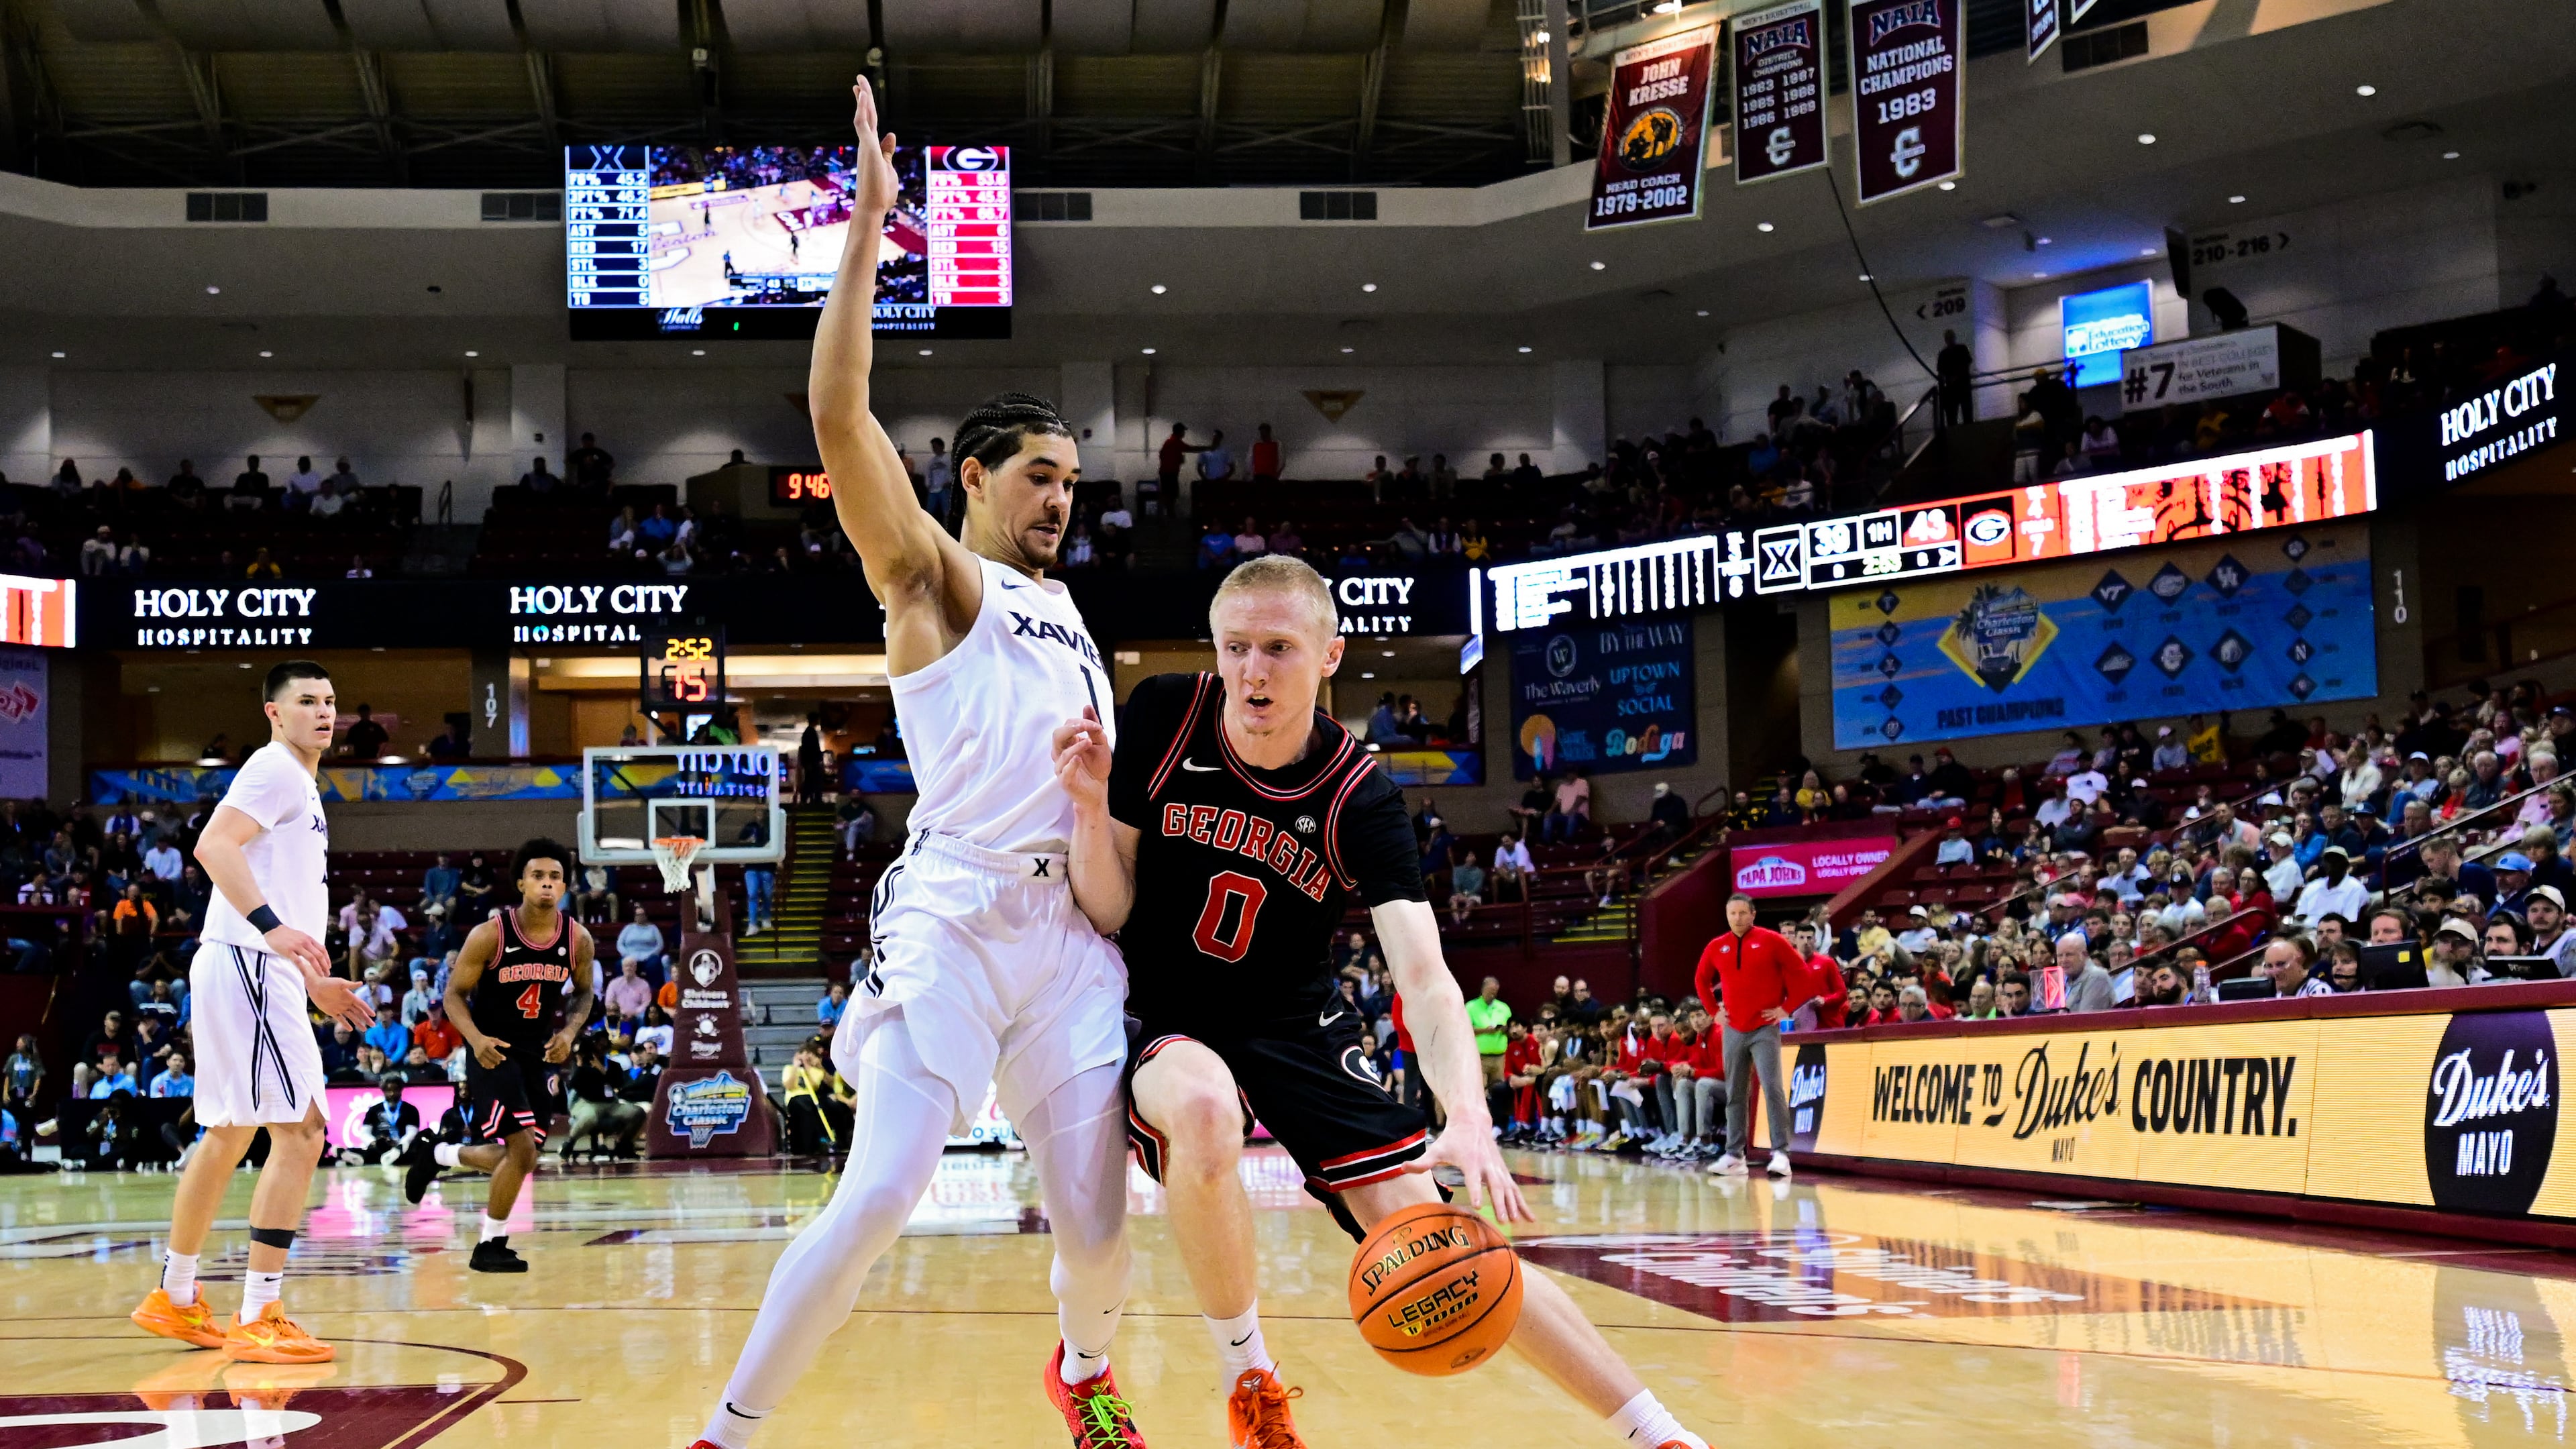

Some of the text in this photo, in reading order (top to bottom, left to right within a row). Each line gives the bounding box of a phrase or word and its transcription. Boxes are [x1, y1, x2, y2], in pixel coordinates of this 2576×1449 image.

[1869, 0, 1941, 47] NAIA
[1744, 18, 1811, 65] NAIA
[1866, 35, 1945, 74] NATIONAL
[1641, 57, 1682, 84] JOHN
[1752, 58, 1804, 78] CHAMPIONS
[1860, 54, 1953, 96] CHAMPIONS
[1628, 76, 1688, 107] KRESSE
[1742, 78, 1774, 97] 1983
[1878, 87, 1936, 125] 1983
[1743, 111, 1775, 129] 1986
[616, 173, 647, 185] 45.2
[1606, 173, 1681, 193] HEAD COACH
[616, 191, 647, 203] 46.2
[977, 191, 1006, 203] 45.5
[1596, 184, 1687, 217] 1979-2002
[570, 207, 647, 219] FT% 71.4
[570, 224, 647, 237] AST 5
[932, 224, 957, 237] AST
[631, 241, 647, 254] 17
[991, 241, 1008, 254] 15
[571, 258, 648, 271] STL 3
[932, 258, 1008, 271] STL 3
[998, 275, 1008, 287] 3
[639, 292, 649, 305] 5
[998, 292, 1008, 305] 3
[1933, 297, 1966, 317] 209
[905, 307, 936, 319] CITY
[2088, 320, 2149, 340] Education
[2089, 333, 2144, 352] Lottery
[2196, 364, 2246, 378] Veterans
[2249, 360, 2260, 370] in
[2125, 362, 2176, 404] #7
[2179, 377, 2233, 394] the South
[2440, 362, 2557, 446] HOLY CITY
[2445, 416, 2558, 482] HOSPITALITY
[1867, 520, 1892, 543] 1H
[1909, 508, 1947, 541] 43
[2029, 533, 2044, 556] 7
[510, 584, 688, 615] HOLY CITY
[1339, 577, 1415, 606] CITY
[134, 588, 316, 618] HOLY CITY
[138, 628, 312, 645] HOSPITALITY
[513, 625, 641, 642] HOSPITAL
[1007, 610, 1108, 677] XAVIE
[1648, 623, 1686, 647] WAY
[666, 638, 712, 661] 2:52
[1610, 661, 1680, 684] UPTOWN
[1080, 663, 1104, 730] 1
[1525, 683, 1548, 700] The
[484, 682, 498, 729] 107
[1617, 695, 1674, 716] SOCIAL
[1937, 698, 2065, 729] PAST CHAMPIONS
[1295, 816, 1316, 834] SEC
[1162, 803, 1331, 902] GEORGIA
[1813, 850, 1889, 868] LOCALLY OWNED
[1032, 858, 1051, 877] X
[1741, 868, 1766, 884] PAPA
[1817, 866, 1848, 878] LOCALLY
[1193, 870, 1267, 963] 0
[498, 963, 569, 983] GEORGIA
[517, 983, 541, 1019] 4
[1872, 1040, 2297, 1139] WELCOME TO Duke's COUNTRY.
[2432, 1047, 2549, 1127] Duke's
[672, 1104, 744, 1117] Charleston
[683, 1116, 729, 1126] Classic
[2051, 1138, 2075, 1163] MAYO
[2456, 1129, 2514, 1176] MAYO
[1362, 1226, 1470, 1297] SPALDING
[1388, 1269, 1479, 1328] LEGACY
[1424, 1292, 1478, 1327] 1000
